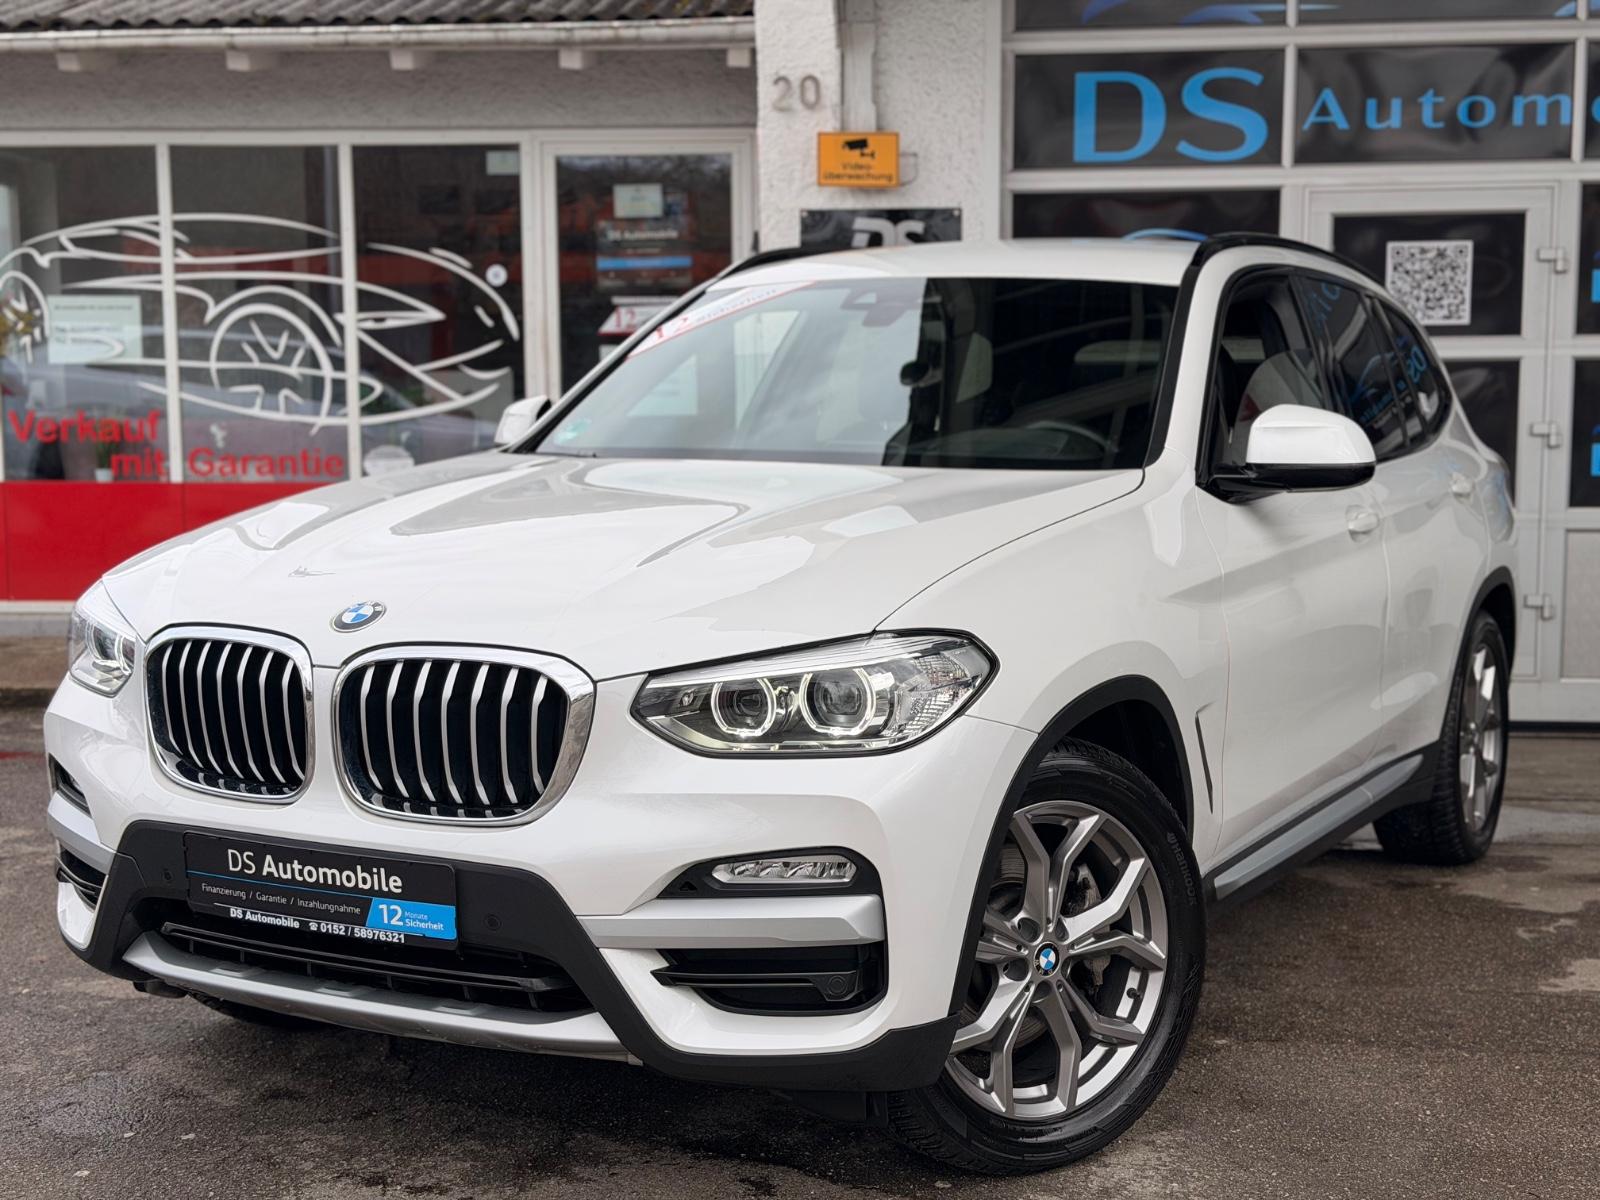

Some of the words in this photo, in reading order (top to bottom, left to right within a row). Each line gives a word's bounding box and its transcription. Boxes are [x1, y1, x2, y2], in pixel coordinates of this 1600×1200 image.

[772, 74, 822, 112] 20
[1072, 67, 1269, 163] DS
[1302, 87, 1600, 131] Autom
[8, 409, 161, 443] Verkauf
[111, 449, 164, 478] mit
[187, 447, 344, 479] Garantie
[227, 849, 256, 875] DS
[262, 854, 403, 894] Automobile
[201, 882, 247, 900] Finanzierung
[256, 892, 287, 905] Garantie
[297, 897, 361, 915] Inzahlungnahme
[378, 904, 404, 926] 12
[229, 907, 243, 919] DS
[245, 911, 300, 929] Automobile
[320, 922, 346, 936] 0152
[354, 928, 405, 944] 58976321
[404, 911, 428, 920] Monate
[405, 918, 444, 931] Sicherheit
